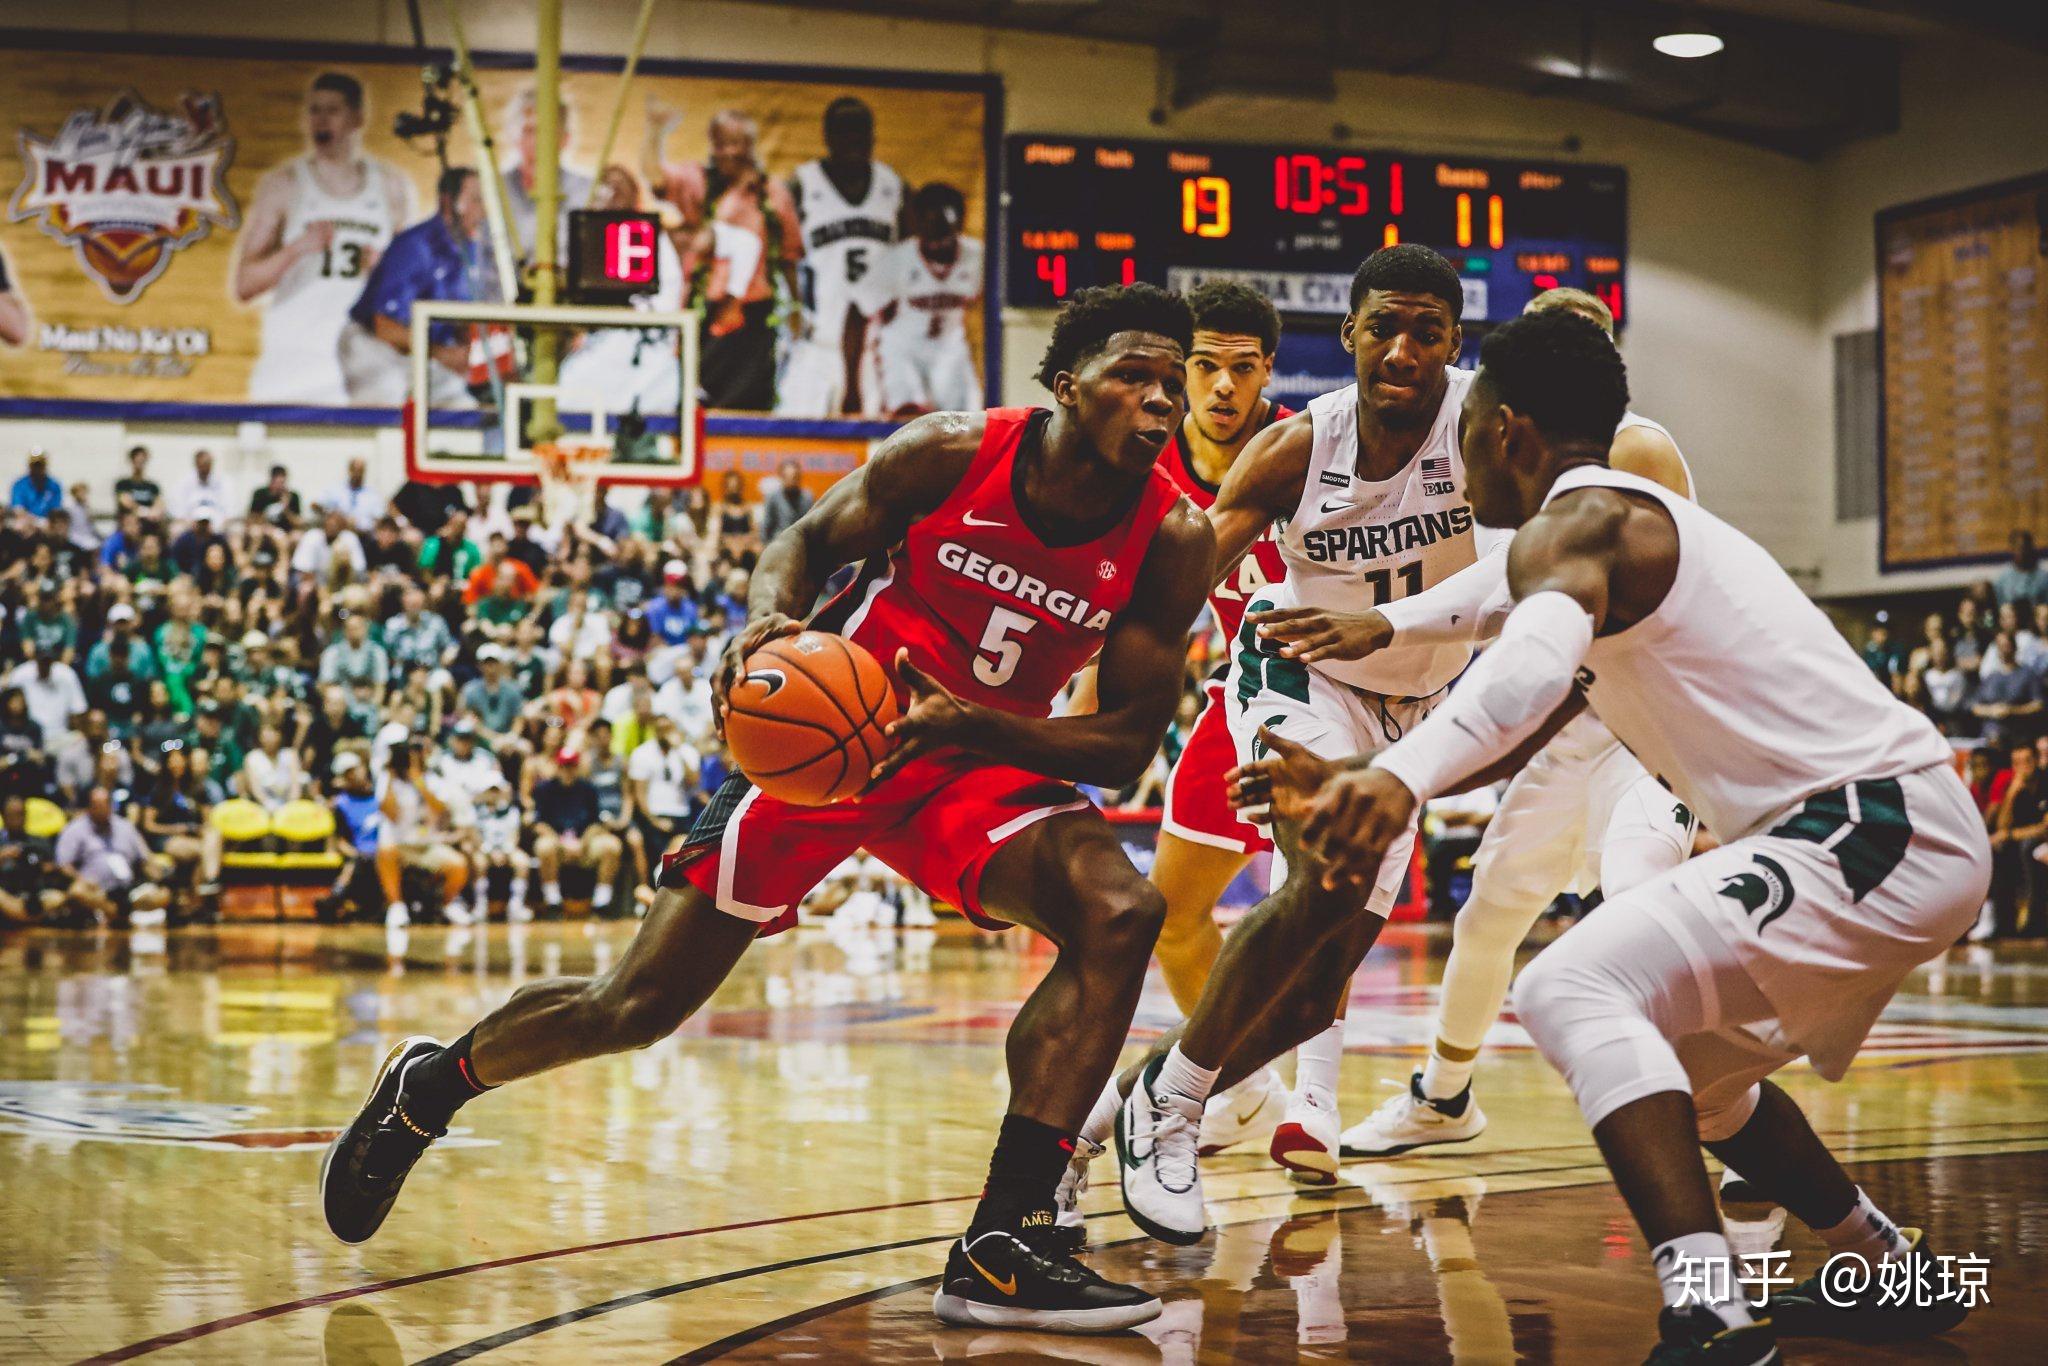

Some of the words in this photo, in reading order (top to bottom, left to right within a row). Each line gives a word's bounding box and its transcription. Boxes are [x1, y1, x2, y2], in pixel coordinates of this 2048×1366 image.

[45, 159, 206, 200] MAUI
[1182, 176, 1231, 237] 19
[1275, 154, 1404, 215] 10:51
[1456, 193, 1504, 250] 11
[320, 242, 361, 278] 13
[846, 248, 868, 282] 5
[1037, 254, 1067, 297] 4
[1303, 505, 1473, 563] SPARTANS
[937, 542, 1112, 631] GEORGIA
[1364, 559, 1424, 607] 11
[972, 605, 1038, 687] 5
